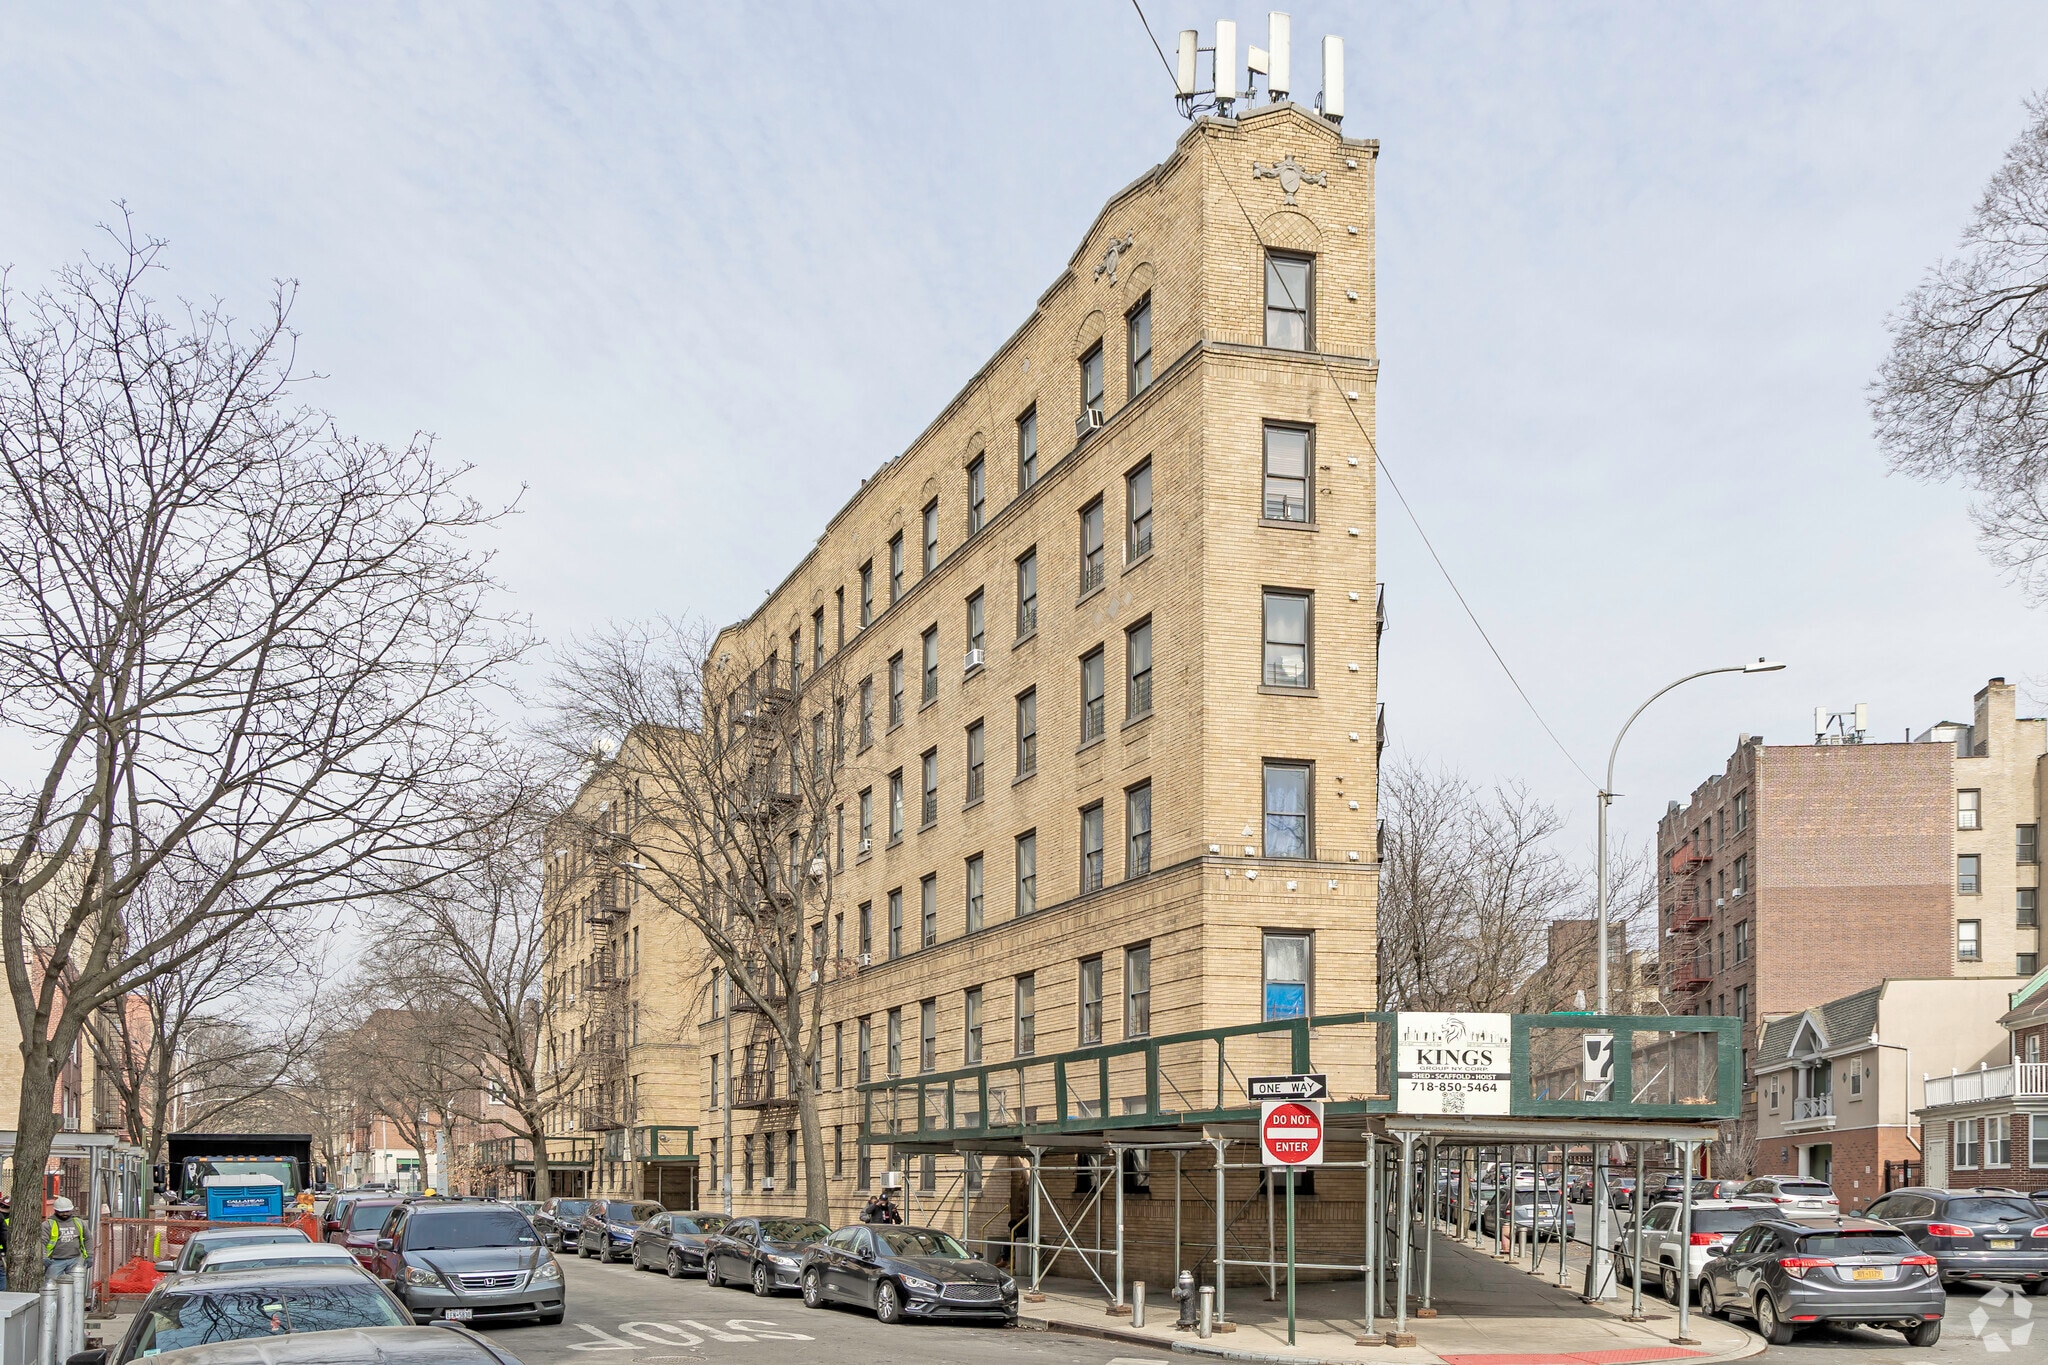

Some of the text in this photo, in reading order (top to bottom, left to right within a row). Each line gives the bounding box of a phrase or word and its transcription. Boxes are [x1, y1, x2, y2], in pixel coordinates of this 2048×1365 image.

[1416, 1049, 1493, 1066] KINGS
[1259, 1082, 1315, 1094] ONE WAY
[1411, 1082, 1498, 1092] 718-850-5464
[1273, 1115, 1311, 1125] DO NOT
[1275, 1142, 1309, 1152] ENTER
[566, 1319, 816, 1351] STOP
